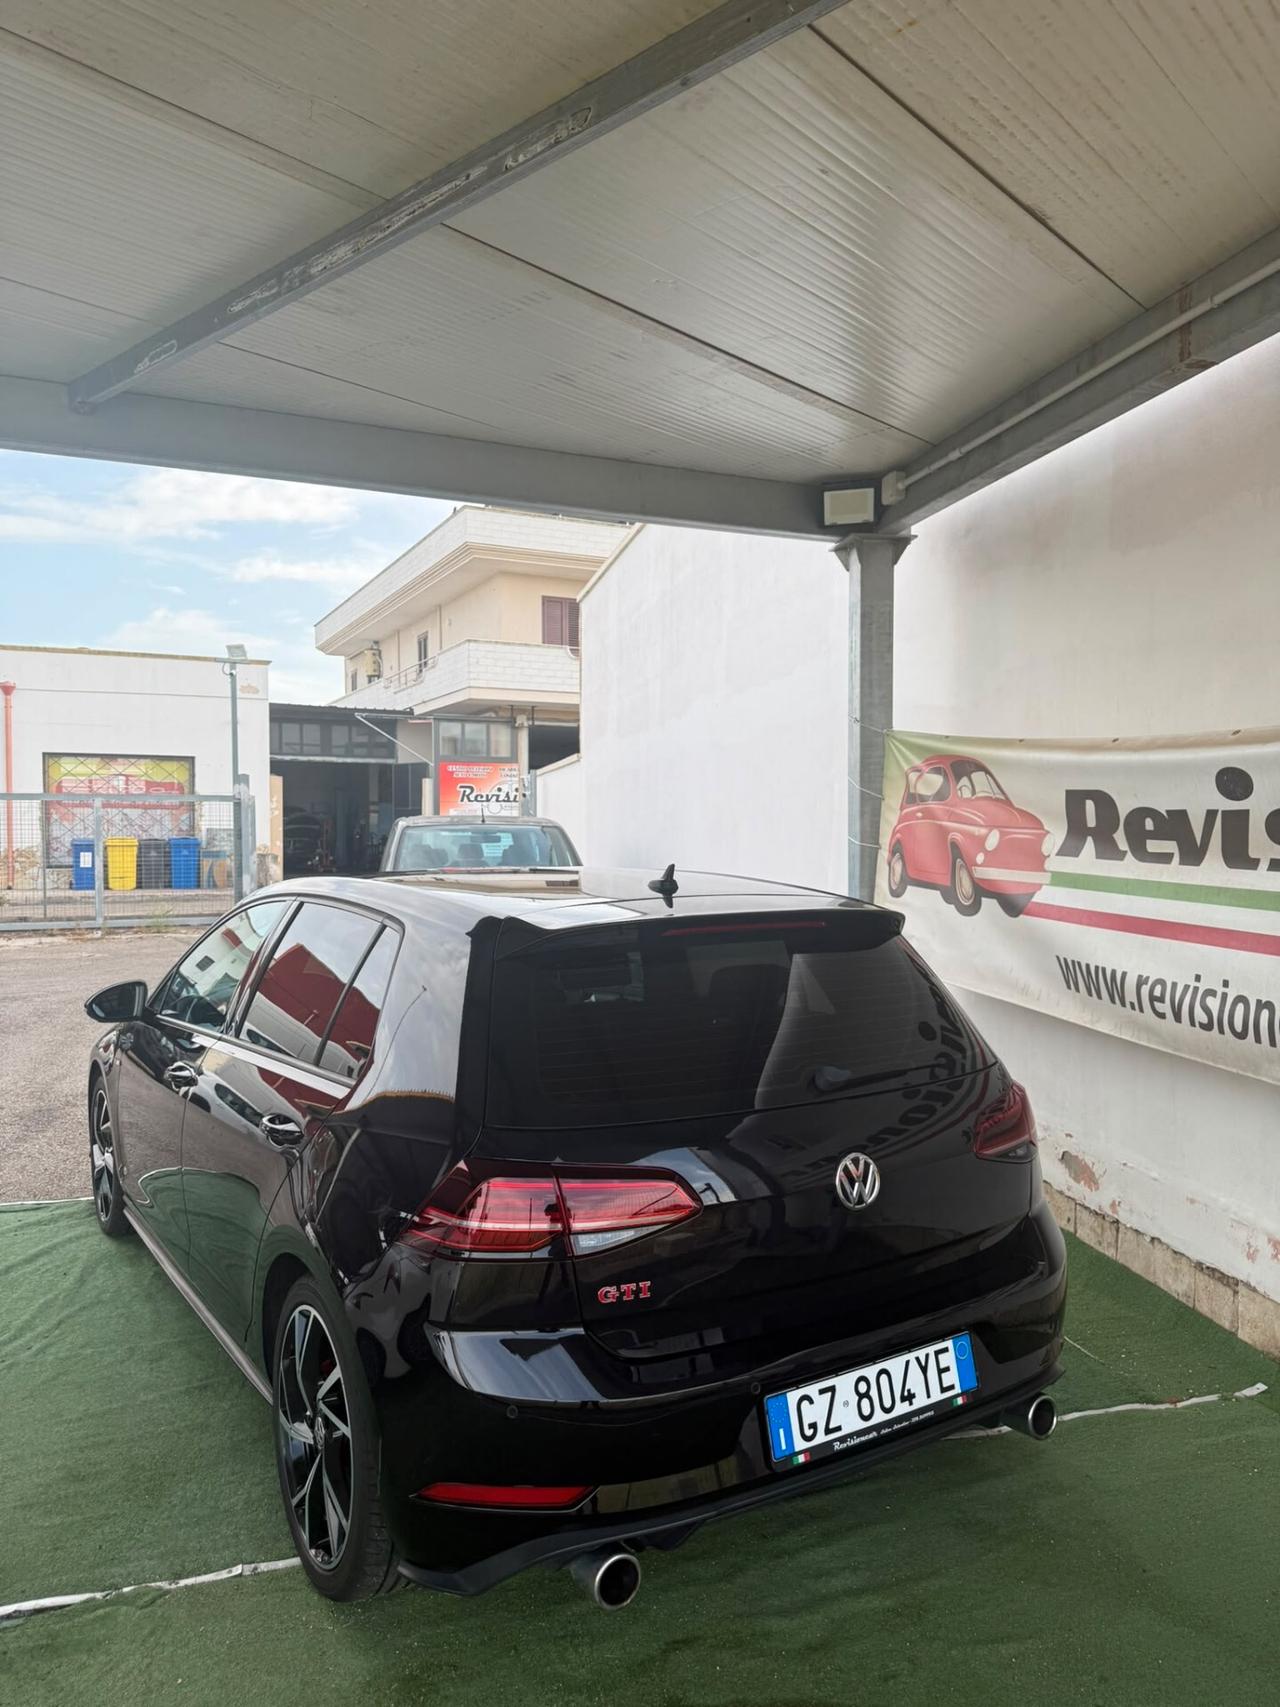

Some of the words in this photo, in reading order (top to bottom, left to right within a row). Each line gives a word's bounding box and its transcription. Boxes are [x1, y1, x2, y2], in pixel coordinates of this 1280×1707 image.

[1055, 954, 1280, 1048] www.revision
[597, 1281, 651, 1303] GTI
[796, 1385, 842, 1443] GZ
[853, 1346, 956, 1422] 804YE
